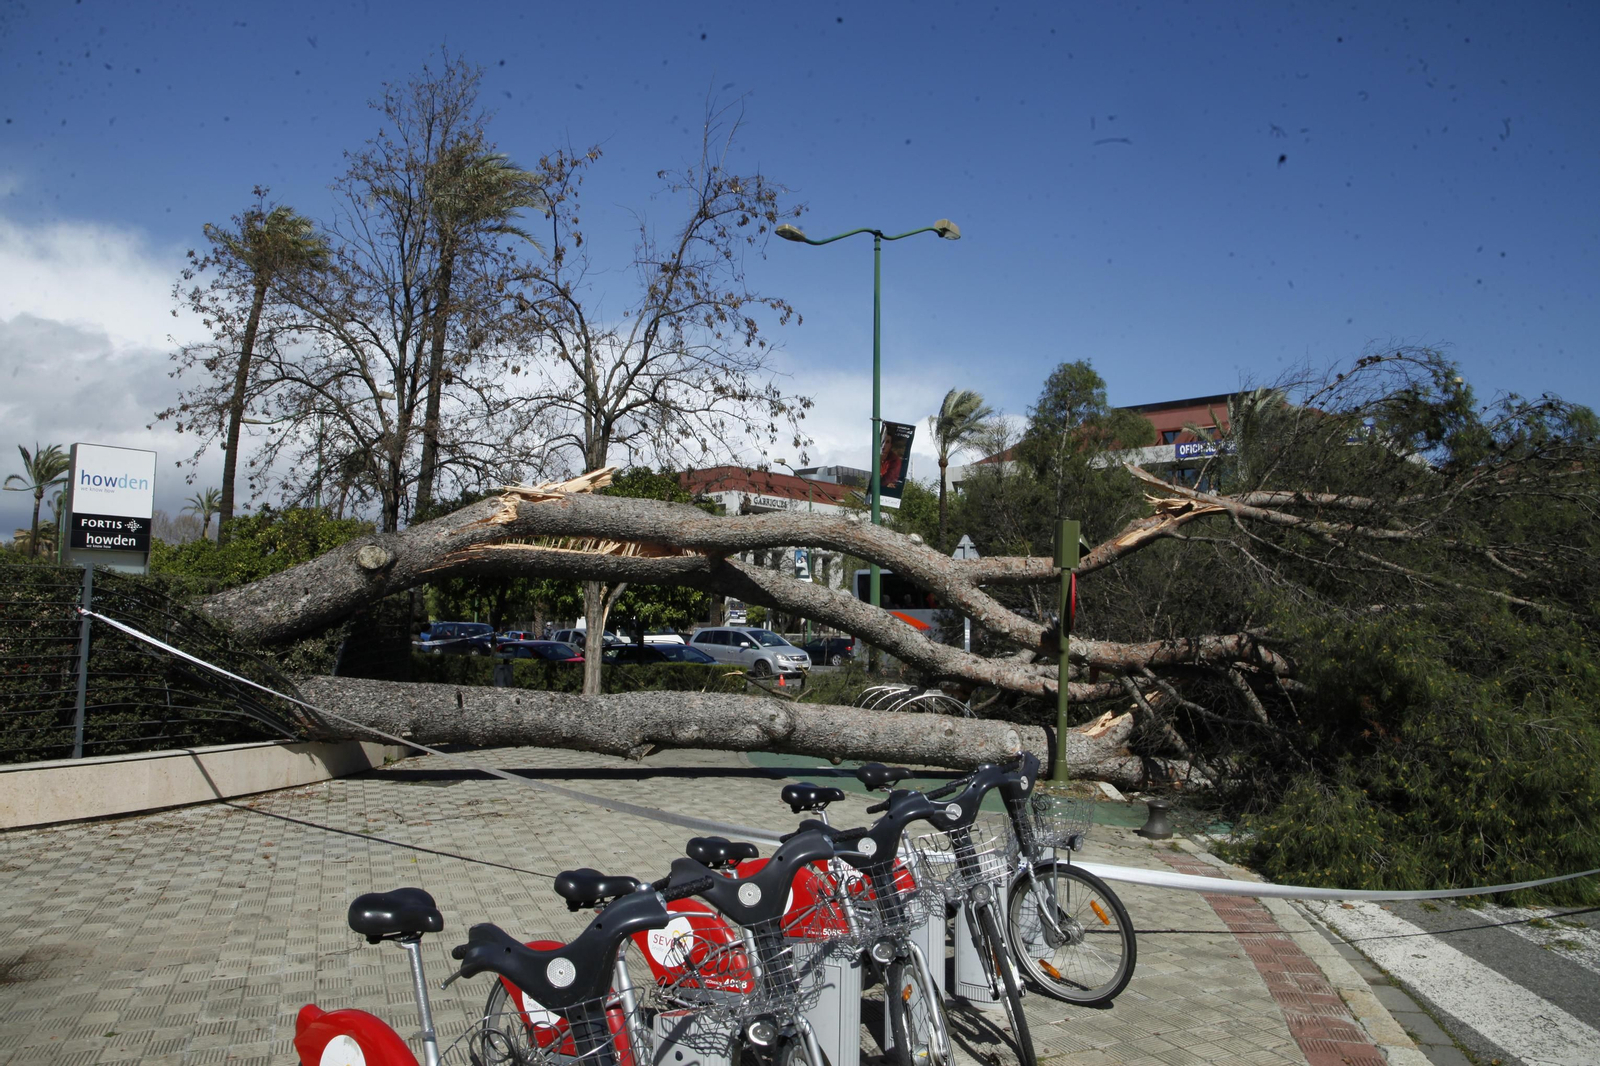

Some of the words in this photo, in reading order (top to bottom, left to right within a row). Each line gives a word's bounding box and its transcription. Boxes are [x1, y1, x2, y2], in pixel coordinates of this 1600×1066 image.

[81, 469, 148, 490] howden
[81, 518, 122, 529] FORTIS
[86, 532, 136, 546] howden
